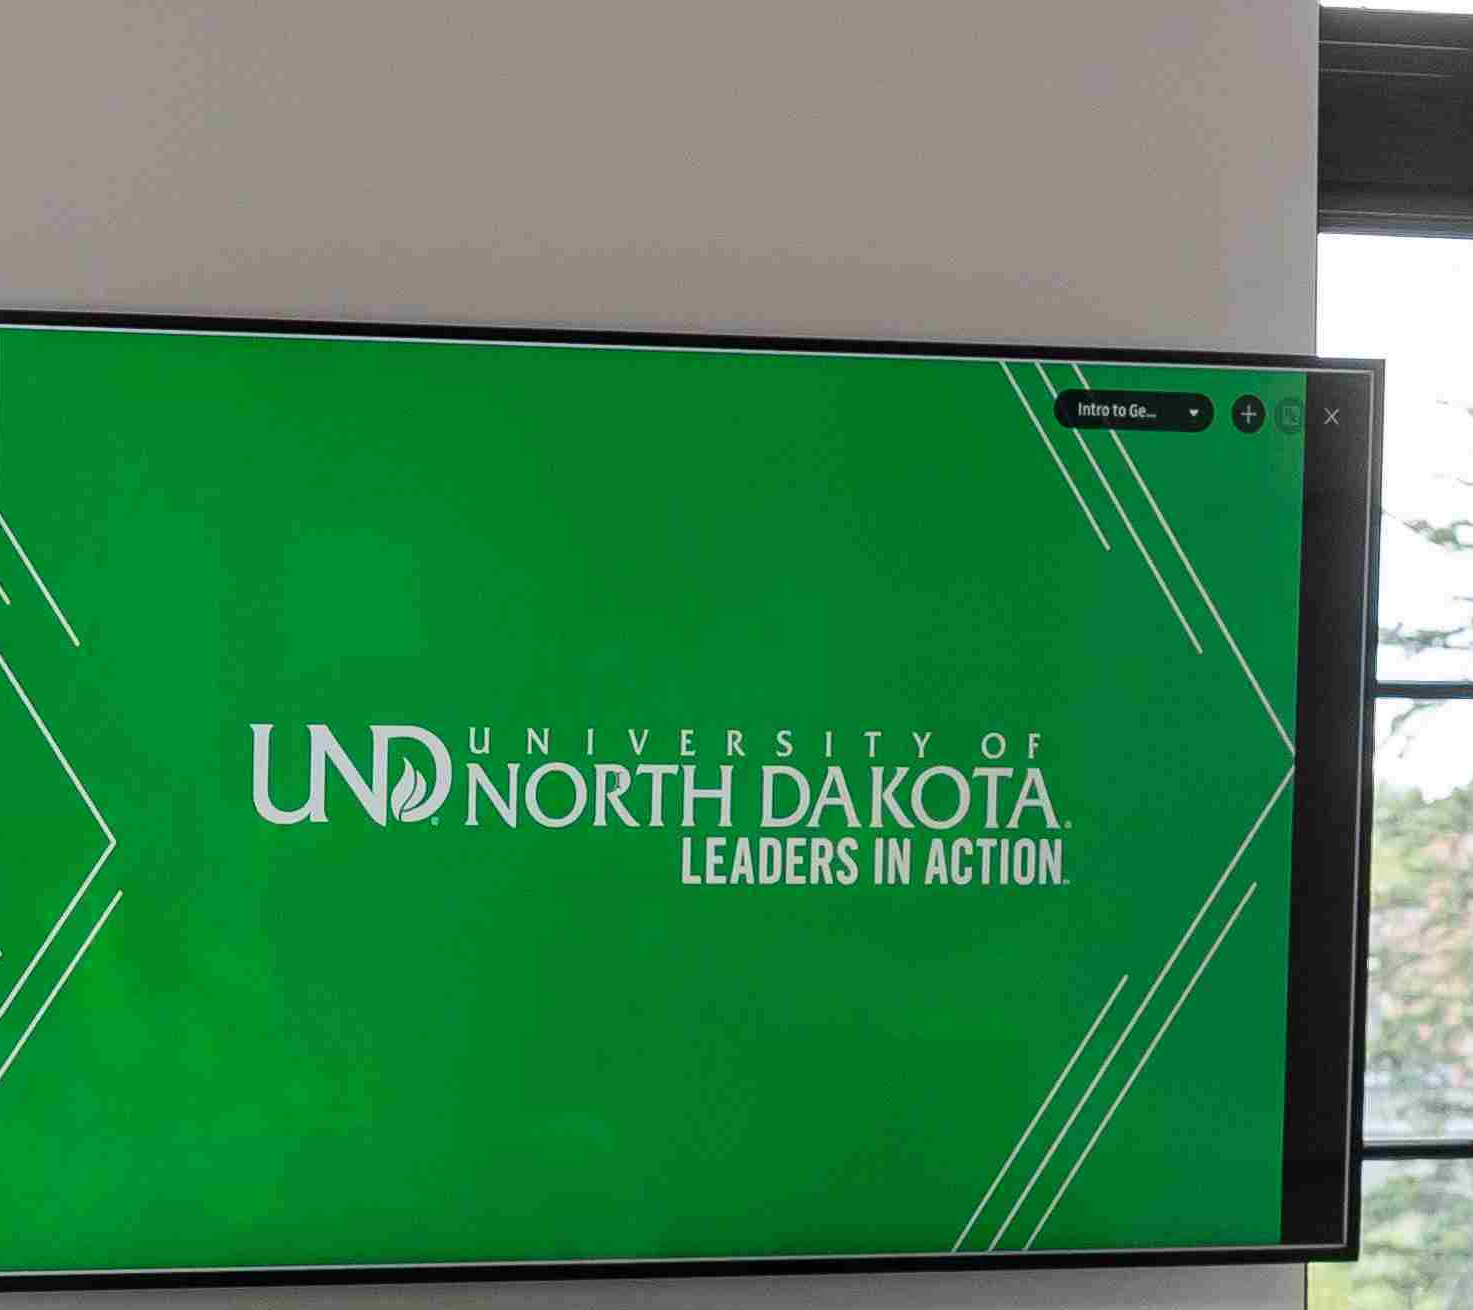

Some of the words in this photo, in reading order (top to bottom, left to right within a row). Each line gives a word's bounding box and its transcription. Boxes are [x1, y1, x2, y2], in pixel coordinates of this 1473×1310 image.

[1077, 401, 1110, 417] Intro
[1112, 404, 1127, 417] to
[469, 726, 932, 759] UNIVERSITY
[980, 731, 1042, 760] OF
[250, 723, 453, 827] UND
[464, 761, 735, 828] NORTH
[681, 836, 859, 886] LEADERS
[874, 837, 911, 885] IN
